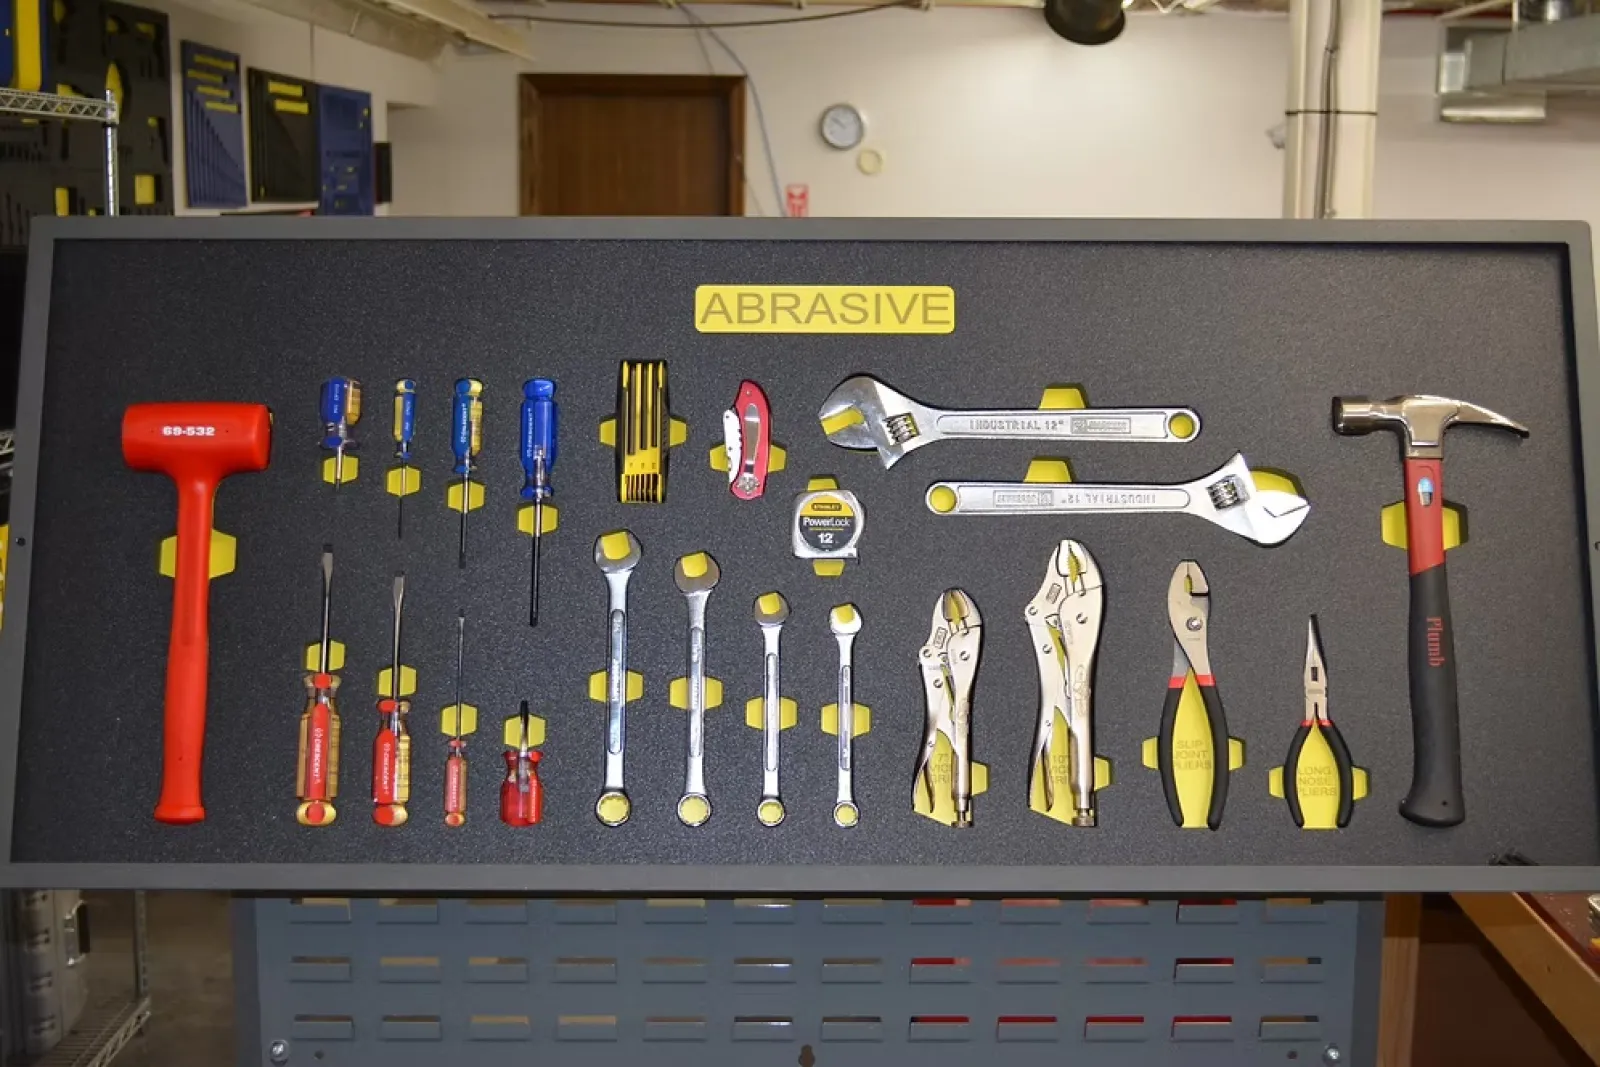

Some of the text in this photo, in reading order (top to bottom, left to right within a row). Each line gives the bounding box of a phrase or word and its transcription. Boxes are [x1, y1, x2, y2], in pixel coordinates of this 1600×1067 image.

[700, 292, 951, 325] ABRASIVE
[969, 419, 1064, 431] INDUSTRIAL 12"
[163, 425, 216, 437] 69-532
[1085, 494, 1156, 504] INDUSTRIAL
[803, 516, 850, 527] PowerLock
[1427, 617, 1444, 667] Plumb
[1177, 740, 1203, 749] SLIP
[1298, 766, 1332, 776] LONG
[1299, 777, 1332, 787] NOSE
